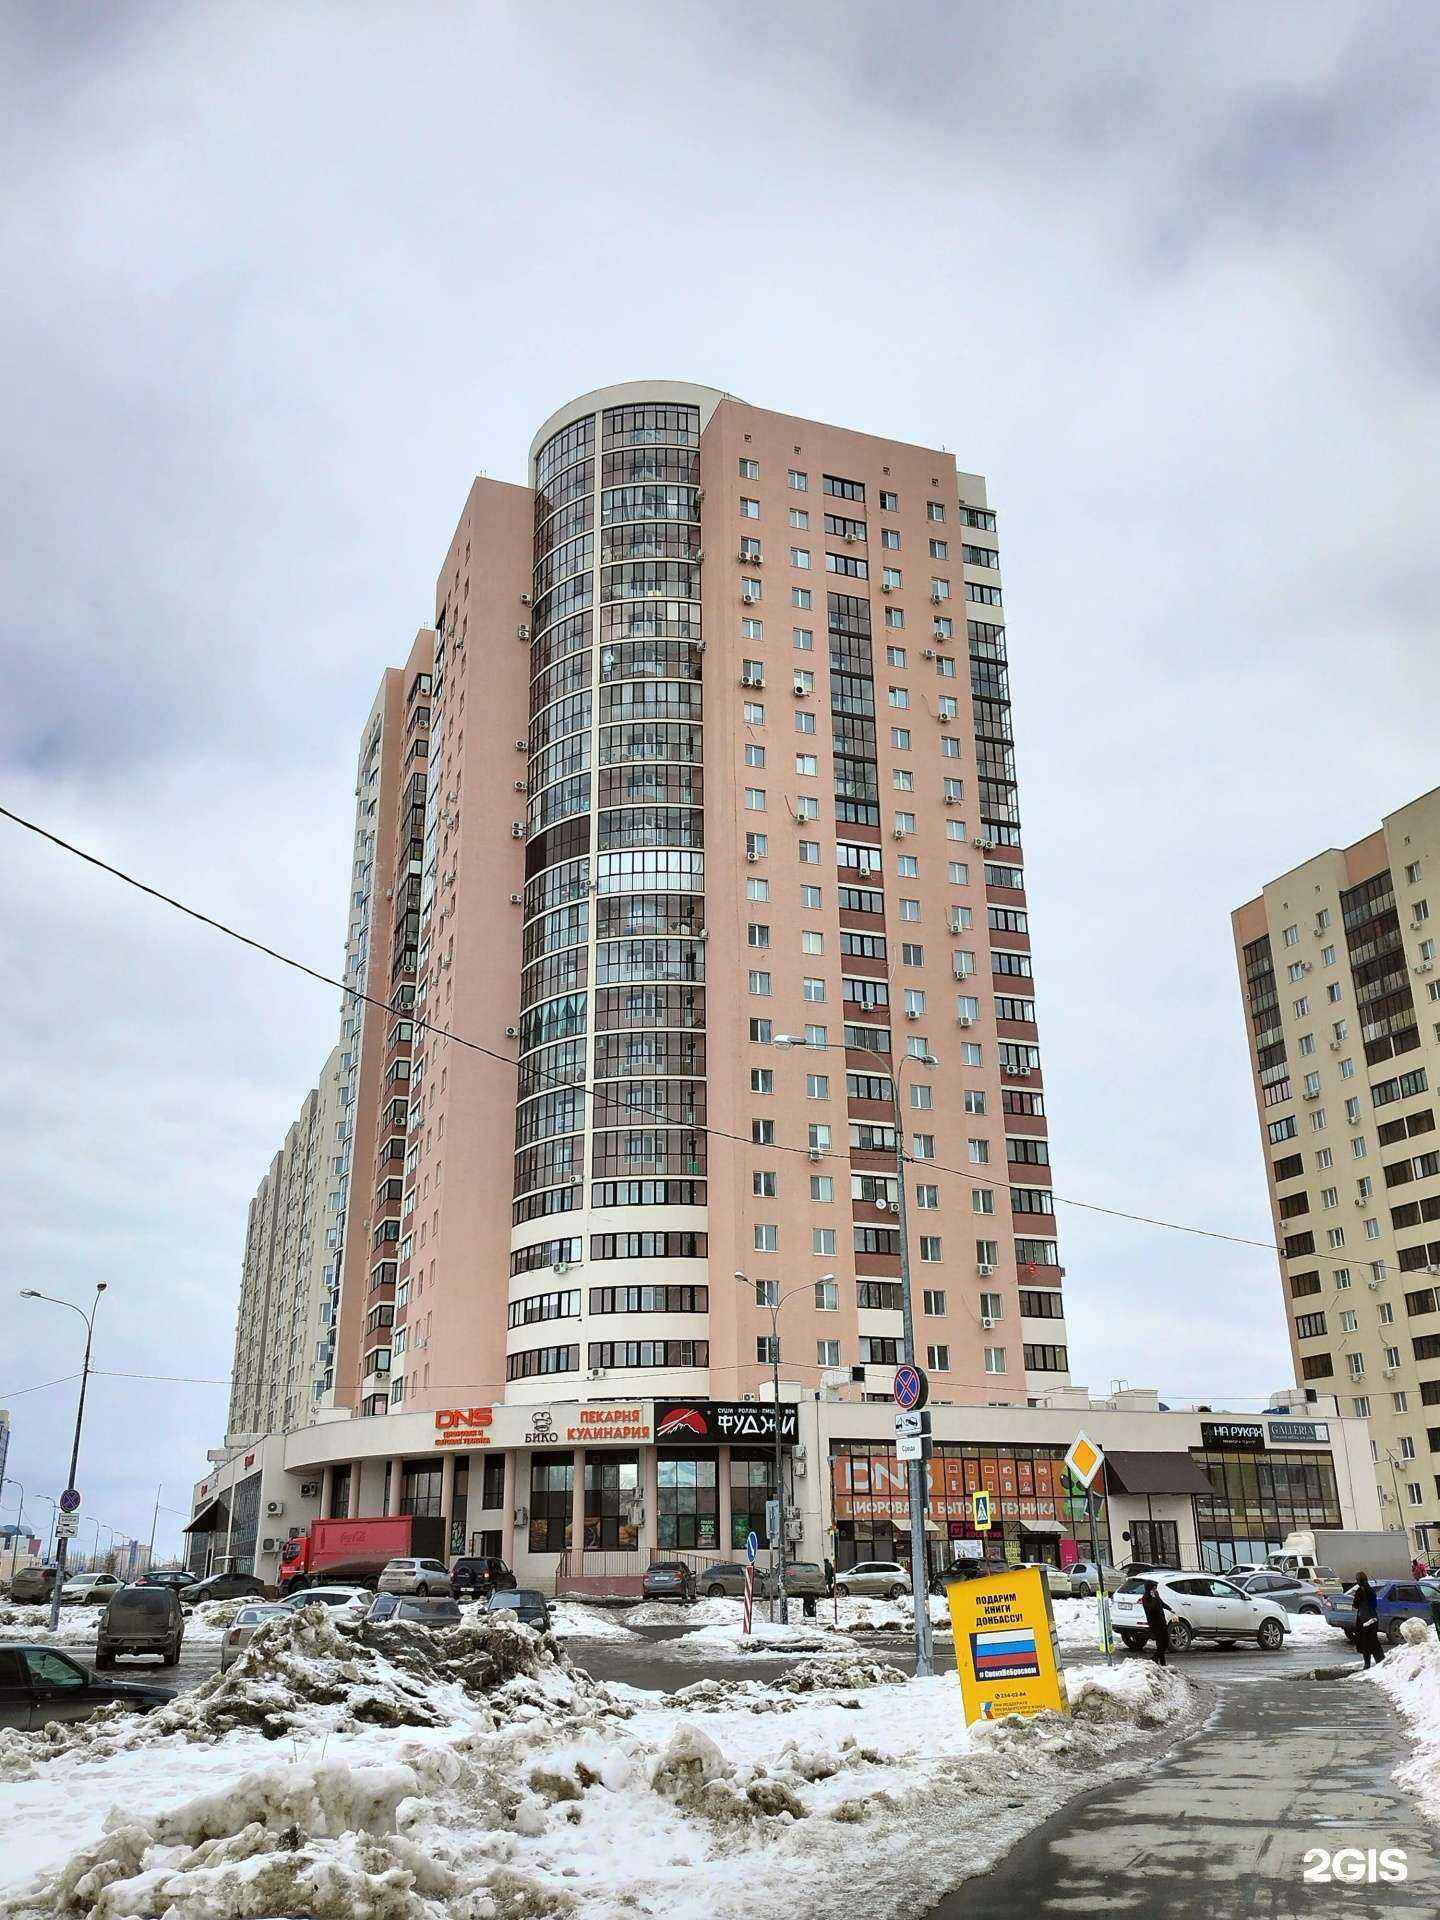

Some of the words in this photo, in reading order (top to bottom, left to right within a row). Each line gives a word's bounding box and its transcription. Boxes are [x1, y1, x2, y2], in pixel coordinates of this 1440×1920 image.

[435, 1408, 493, 1428] DNS
[580, 1409, 640, 1423] ПЕКАРНЯ
[567, 1426, 650, 1441] КУЛИНАРИЯ
[1214, 1426, 1229, 1436] НА
[1231, 1426, 1264, 1437] РУКАХ
[1271, 1424, 1314, 1435] GALLERIA
[525, 1432, 558, 1443] БИКО
[937, 1501, 997, 1516] БЫТОЯ
[1001, 1502, 1056, 1515] ТЕХНИКА
[975, 1593, 1016, 1604] ПОДАРИМ
[984, 1604, 1011, 1615] КНИГИ
[976, 1614, 1023, 1627] ДОНБАССУ!
